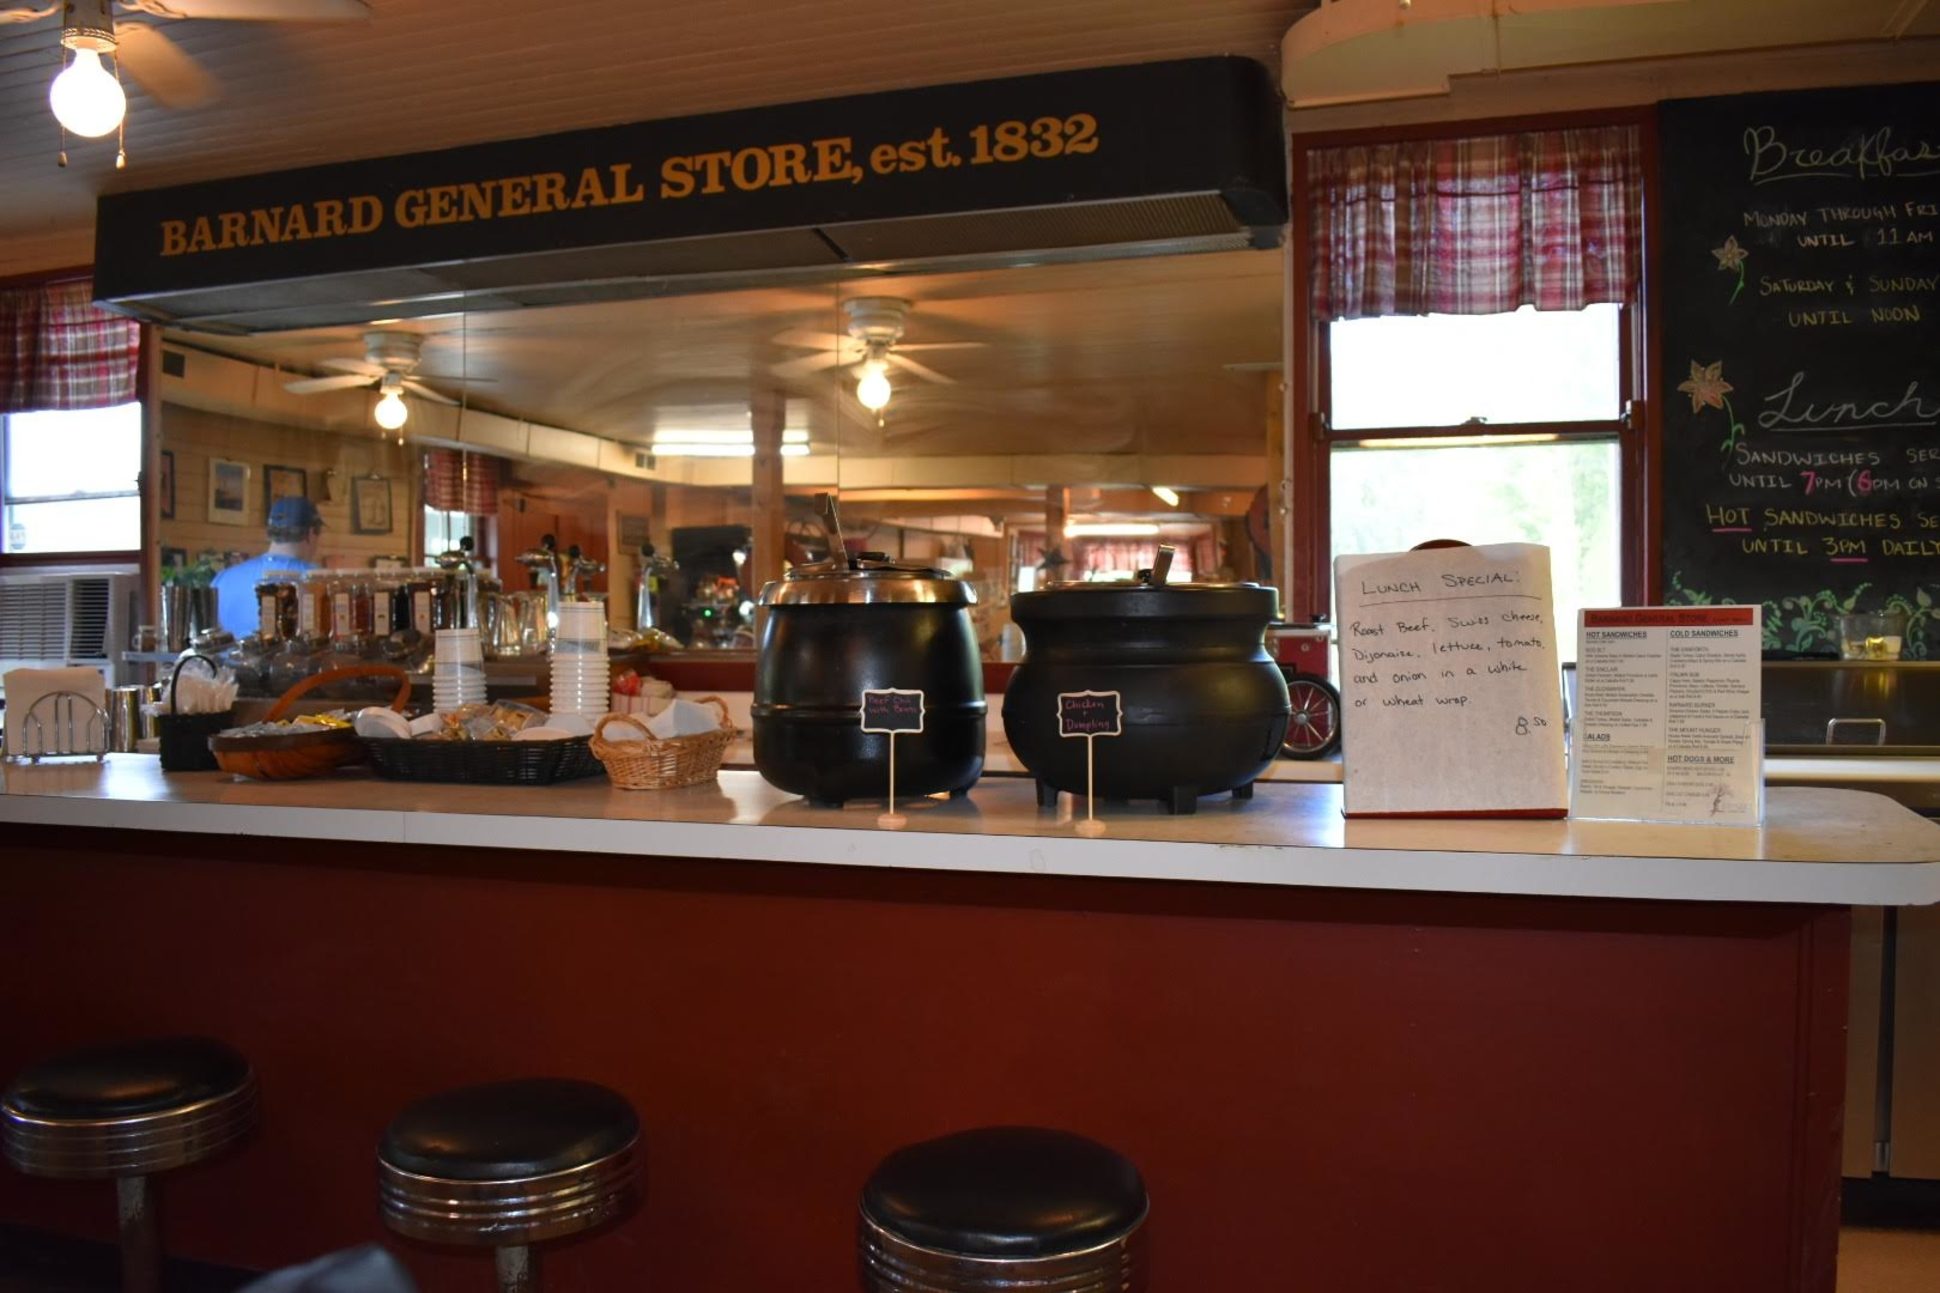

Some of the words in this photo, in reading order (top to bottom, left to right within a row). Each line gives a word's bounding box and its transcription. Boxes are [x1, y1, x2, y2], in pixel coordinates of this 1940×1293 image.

[1744, 126, 1940, 181] Breakfas
[160, 195, 384, 257] BARNARD
[394, 163, 645, 229] GENERAL
[659, 136, 864, 199] STORE,
[870, 126, 963, 176] est.
[969, 112, 1100, 166] 1832
[1744, 211, 1807, 227] MONDAY
[1817, 204, 1896, 222] THROUGH
[1797, 233, 1855, 248] UNTIL
[1876, 227, 1900, 246] 11
[1906, 231, 1934, 244] AM
[1759, 275, 1836, 297] SATURDAY
[1867, 274, 1940, 293] SUNDAY
[1788, 310, 1853, 328] UNTIL
[1871, 304, 1921, 323] NOON
[1758, 371, 1940, 427] Lunch
[1735, 442, 1881, 466] SANDWICHES
[1729, 474, 1793, 489] UNTIL
[1799, 471, 1842, 495] 7PM
[1908, 477, 1928, 489] ON
[1706, 504, 1750, 526] HOT
[1763, 510, 1901, 530] SANDWICHES
[1741, 538, 1809, 556] UNTIL
[1822, 537, 1867, 555] 3PM
[1881, 538, 1940, 557] DAILY
[1361, 581, 1421, 595] LUNCH
[1441, 570, 1520, 588] SPECIAL:
[1447, 616, 1489, 629] Swiss
[1692, 629, 1738, 637] SANDWICHES
[1353, 673, 1378, 684] and
[1392, 671, 1427, 684] onion
[1441, 669, 1455, 679] in
[1465, 667, 1476, 675] a
[1487, 661, 1528, 674] white
[1354, 696, 1368, 708] or
[1383, 694, 1424, 707] wheat
[1667, 755, 1682, 763] HOT
[1713, 756, 1735, 764] MORE
